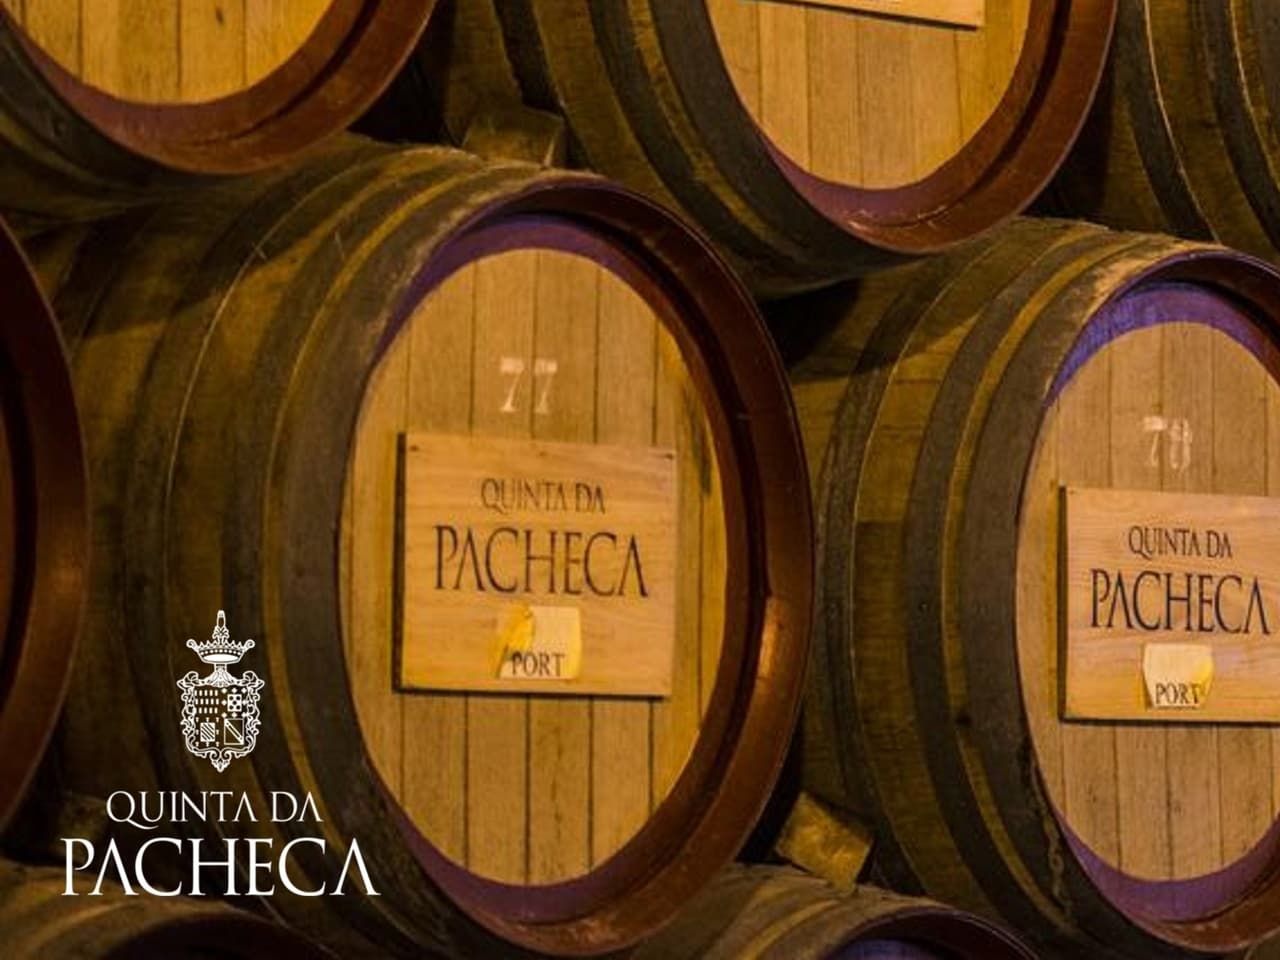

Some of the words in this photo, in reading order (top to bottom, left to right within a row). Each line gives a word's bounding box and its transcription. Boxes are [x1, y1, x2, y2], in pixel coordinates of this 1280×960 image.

[499, 356, 558, 414] 77
[480, 477, 569, 515] QUINTA
[574, 482, 607, 515] DA
[433, 524, 649, 599] PACHECA
[1127, 525, 1202, 560] QUINTA
[1206, 529, 1234, 559] DA
[1090, 567, 1272, 636] PACHECA
[510, 651, 566, 677] PORT
[1154, 682, 1205, 706] PORT
